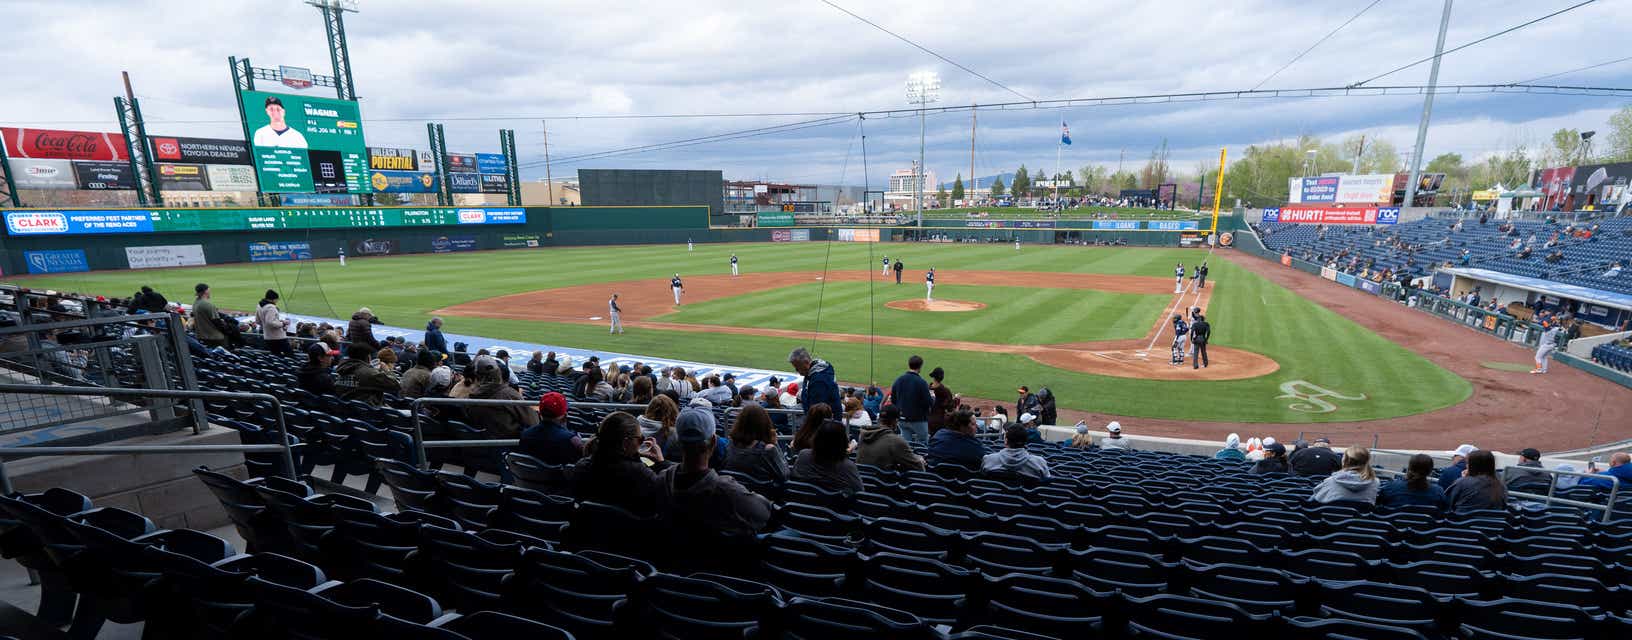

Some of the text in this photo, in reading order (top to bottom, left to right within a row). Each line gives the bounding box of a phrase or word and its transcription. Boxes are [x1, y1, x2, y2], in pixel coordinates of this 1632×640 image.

[304, 108, 339, 117] WAGNER
[180, 143, 219, 151] NORTHERN
[371, 156, 415, 170] POTENTIAL
[97, 173, 119, 181] Findlay
[1263, 208, 1323, 221] roc HURT!
[1378, 208, 1398, 218] roc
[18, 218, 58, 227] CLARK
[46, 258, 82, 266] NEVADA
